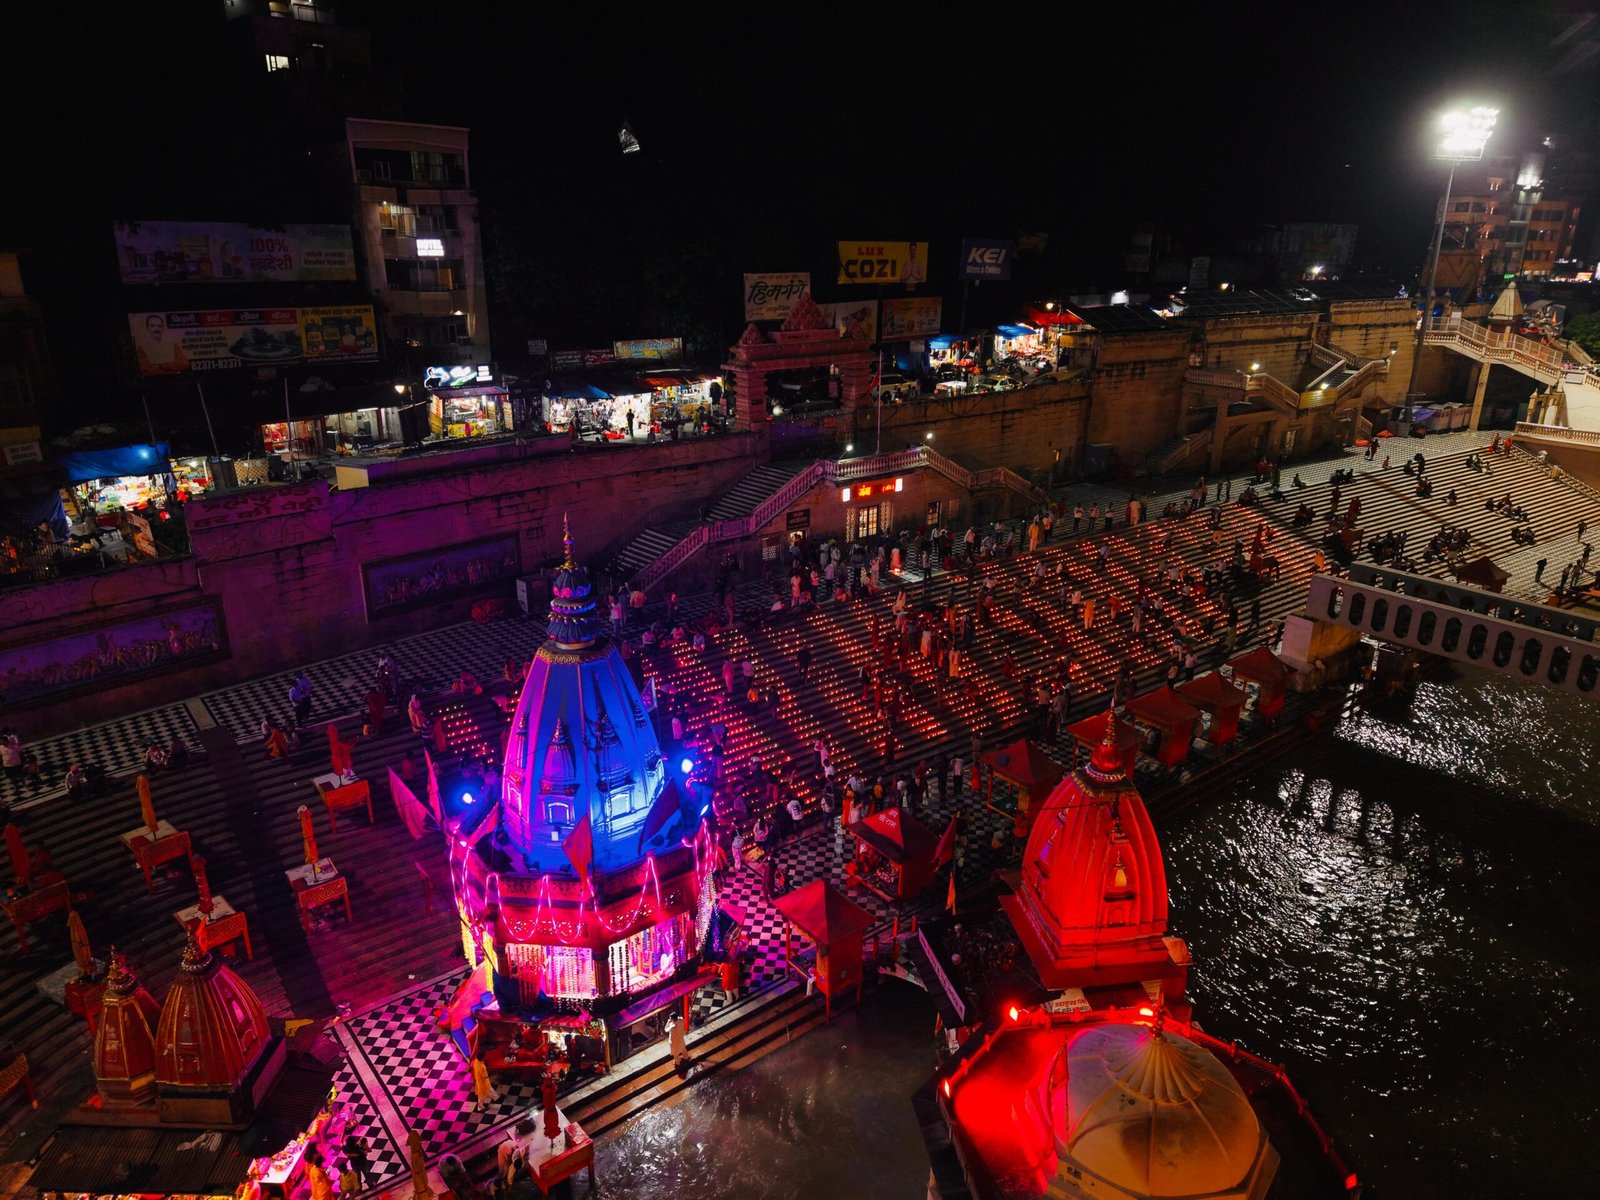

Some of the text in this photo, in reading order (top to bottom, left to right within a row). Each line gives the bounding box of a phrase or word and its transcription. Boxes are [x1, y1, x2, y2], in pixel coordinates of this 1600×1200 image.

[250, 239, 289, 252] 100%
[857, 247, 885, 256] LUX
[967, 247, 1007, 264] KEI
[845, 259, 897, 278] COZI
